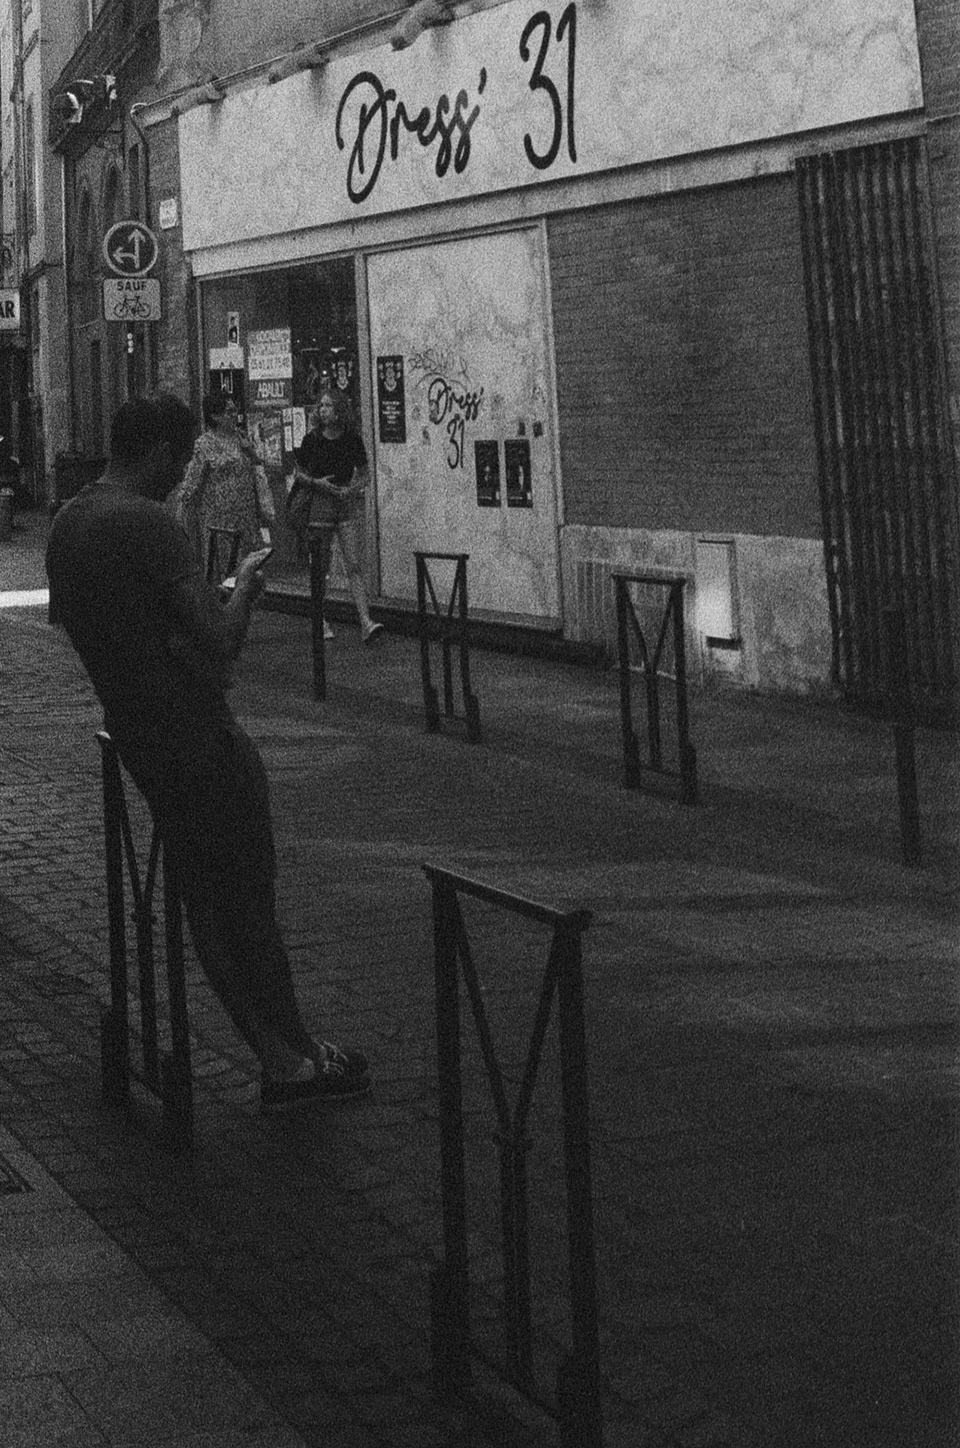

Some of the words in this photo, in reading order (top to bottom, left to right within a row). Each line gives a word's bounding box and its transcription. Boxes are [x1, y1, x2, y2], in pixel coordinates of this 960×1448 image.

[335, 67, 487, 204] Dress'
[518, 2, 578, 170] 31
[116, 281, 148, 291] SAUF
[428, 377, 485, 425] Dress'
[446, 413, 465, 470] 31
